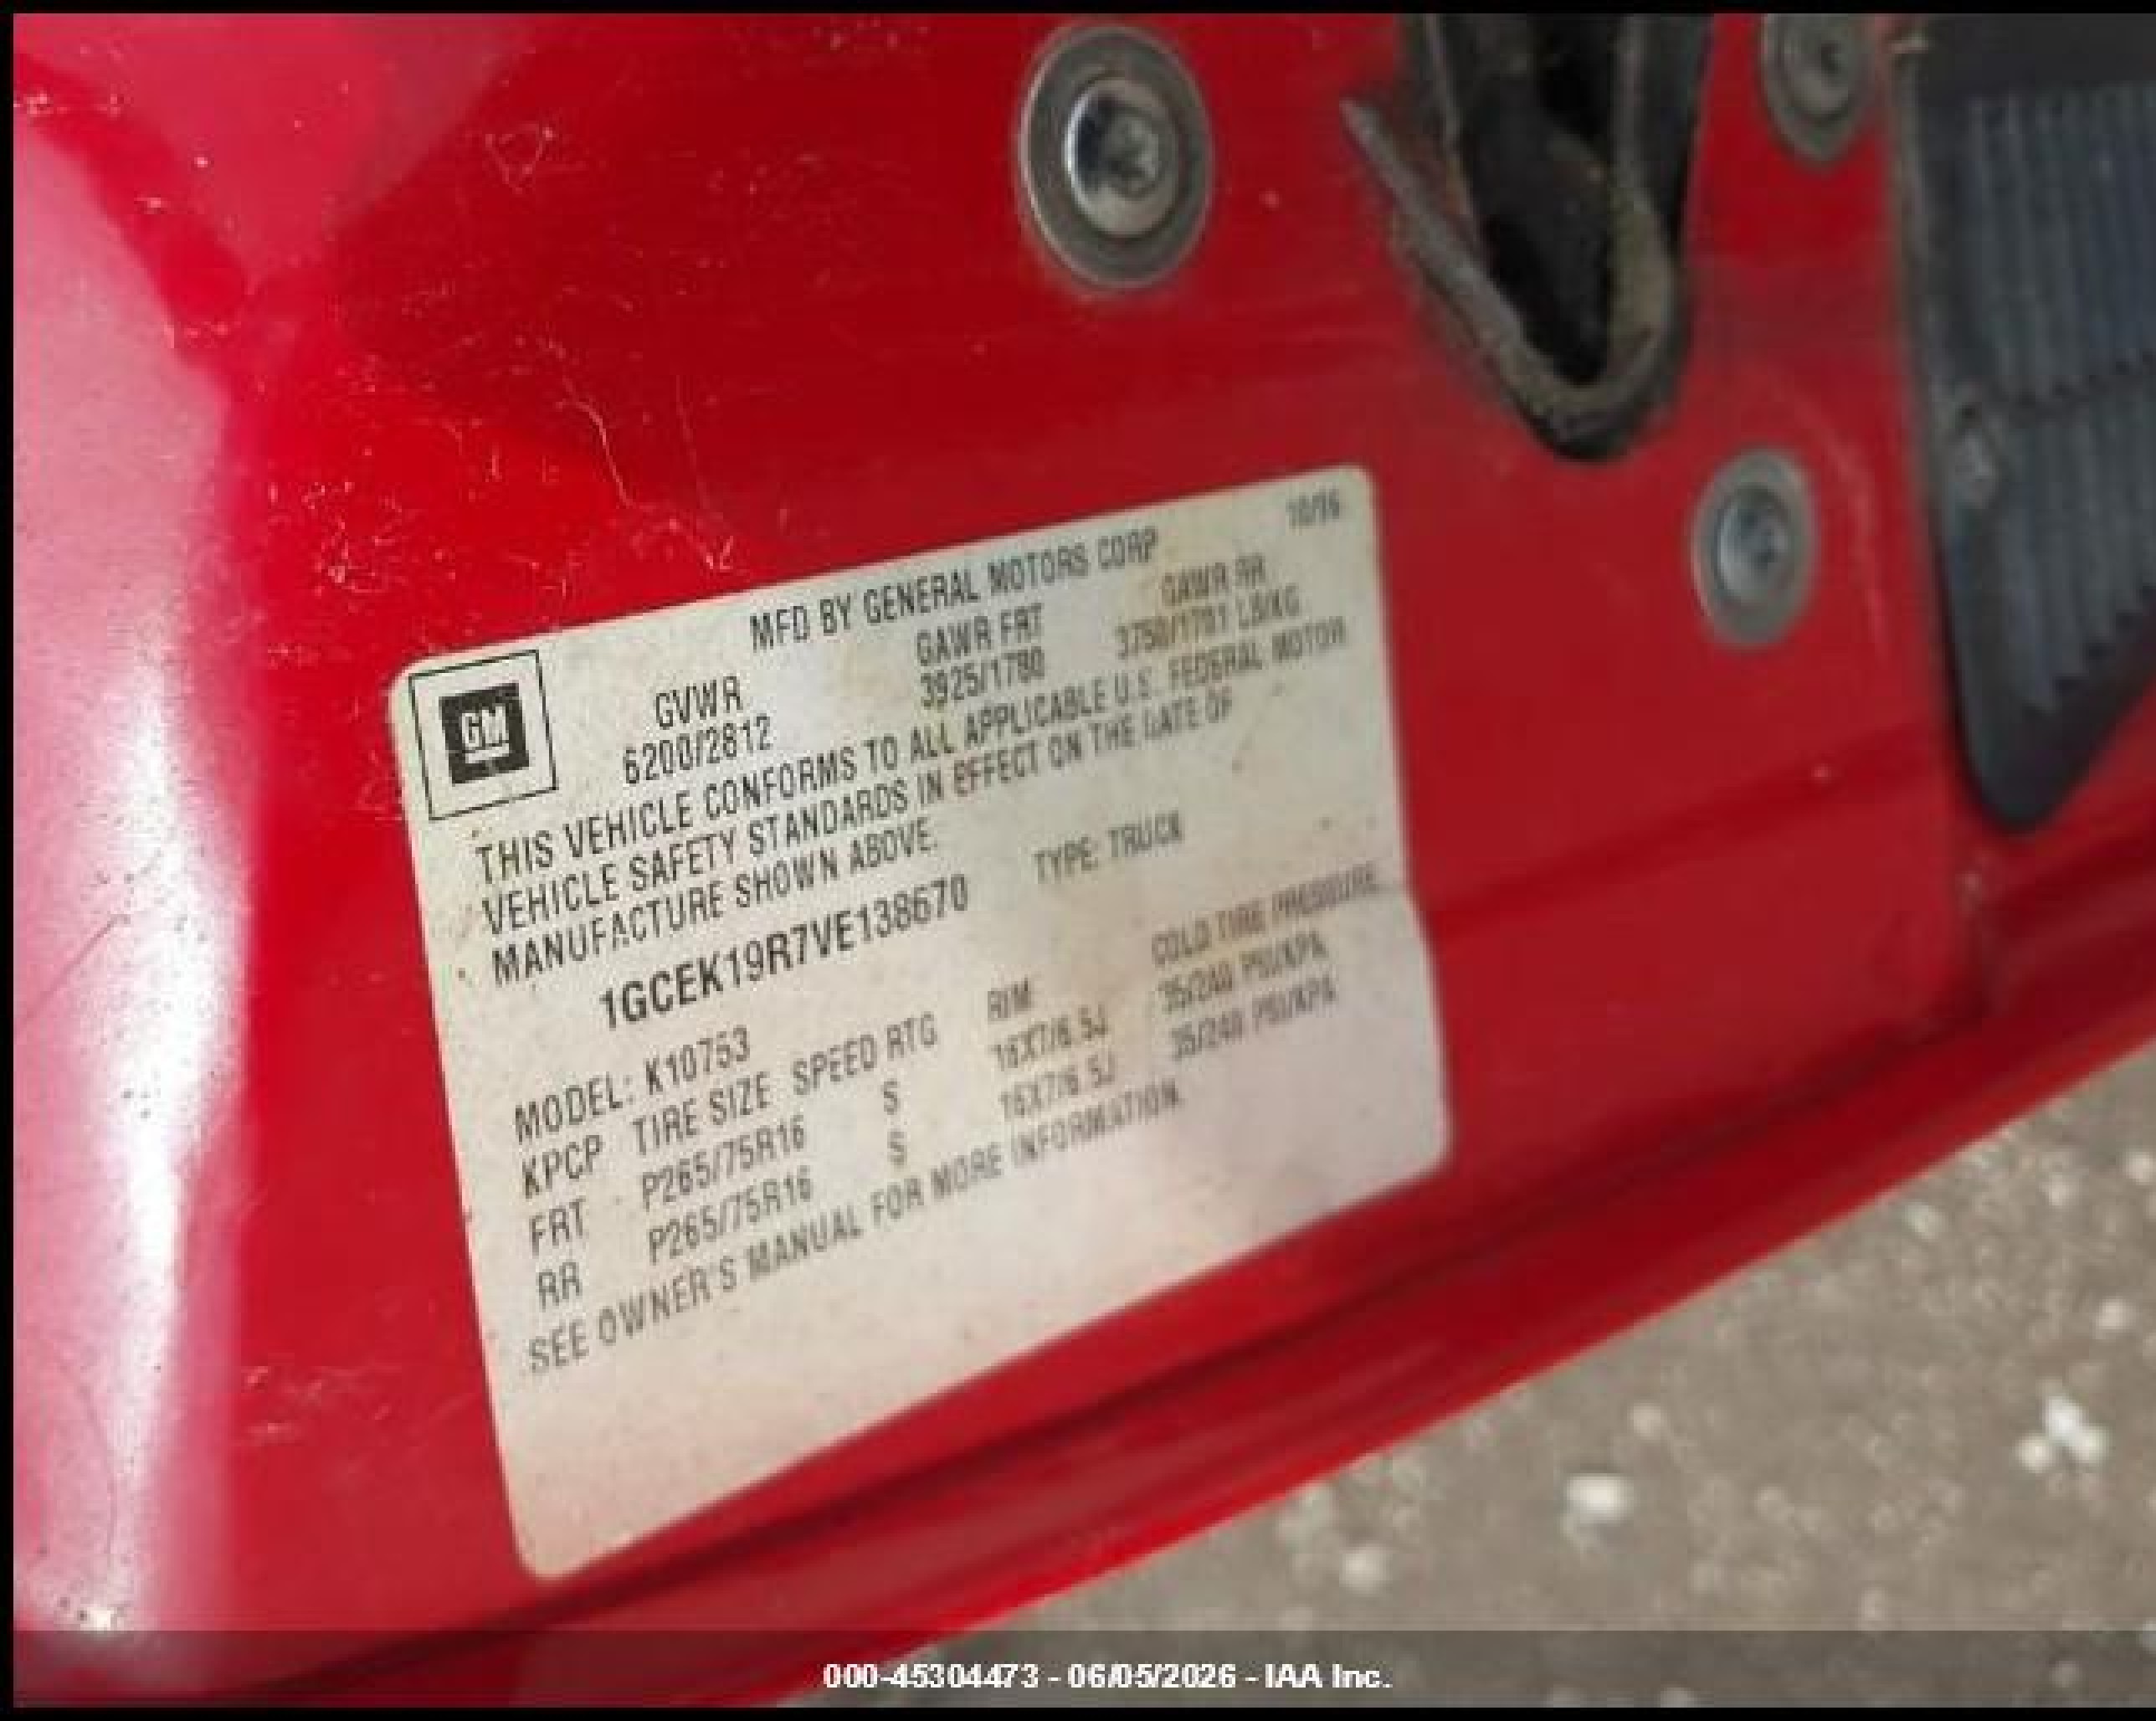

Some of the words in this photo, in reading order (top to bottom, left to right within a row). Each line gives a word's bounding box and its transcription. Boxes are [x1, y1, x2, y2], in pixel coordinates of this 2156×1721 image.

[750, 604, 809, 651] MFD
[820, 593, 852, 636] BY
[863, 567, 979, 624] GENERAL
[988, 542, 1088, 594] MOTORS
[1097, 527, 1158, 564] CORP
[916, 616, 993, 665] GAWR
[1000, 603, 1044, 641] FRT
[654, 675, 742, 729] GVWR
[921, 647, 1045, 709] 3925/1780
[461, 706, 510, 749] GM
[475, 830, 554, 886] THIS
[566, 791, 693, 859] VEHICLE
[705, 748, 858, 820] CONFORMS
[864, 736, 898, 771] TO
[910, 722, 955, 763] ALL
[963, 678, 1105, 745] APPLICABLE
[1114, 666, 1158, 705] U.S.
[1168, 640, 1263, 692] FEDERAL
[1270, 616, 1347, 664] MOTOR
[623, 716, 771, 785] 6200/2812
[482, 862, 619, 936] VEHICLE
[629, 825, 737, 891] SAFETY
[750, 779, 908, 857] STANDARDS
[918, 761, 945, 804] IN
[952, 741, 1039, 797] EFFECT
[1050, 734, 1082, 769] ON
[1088, 712, 1134, 755] THE
[1143, 694, 1199, 739] DATE
[1206, 686, 1234, 723] OF
[1034, 838, 1099, 885] TYPE:
[1108, 809, 1183, 860] TRUCK
[492, 880, 724, 986] MANUFACTURE
[736, 847, 839, 910] SHOWN
[850, 817, 938, 875] ABOVE.
[599, 874, 968, 1027] 1GCEK19R7VE138670
[1152, 920, 1211, 968] COLD
[987, 978, 1032, 1022] RIM
[514, 1072, 635, 1144] MODEL:
[644, 1027, 752, 1095] K10753
[793, 1035, 878, 1096] SPEED
[887, 1012, 938, 1060] RTG
[633, 1098, 698, 1156] TIRE
[709, 1072, 771, 1127] SIZE
[883, 1081, 900, 1115] S
[521, 1135, 603, 1199] KPCP
[641, 1114, 806, 1210] P265/75R16
[889, 1132, 907, 1168] S
[529, 1200, 587, 1256] FRT
[649, 1165, 814, 1265] P265/75R16
[529, 1318, 588, 1374] SEE
[598, 1256, 737, 1347] OWNER'S
[748, 1207, 862, 1282] MANUAL
[871, 1176, 924, 1225] FOR
[931, 1143, 1002, 1200] MORE
[537, 1261, 583, 1313] RR
